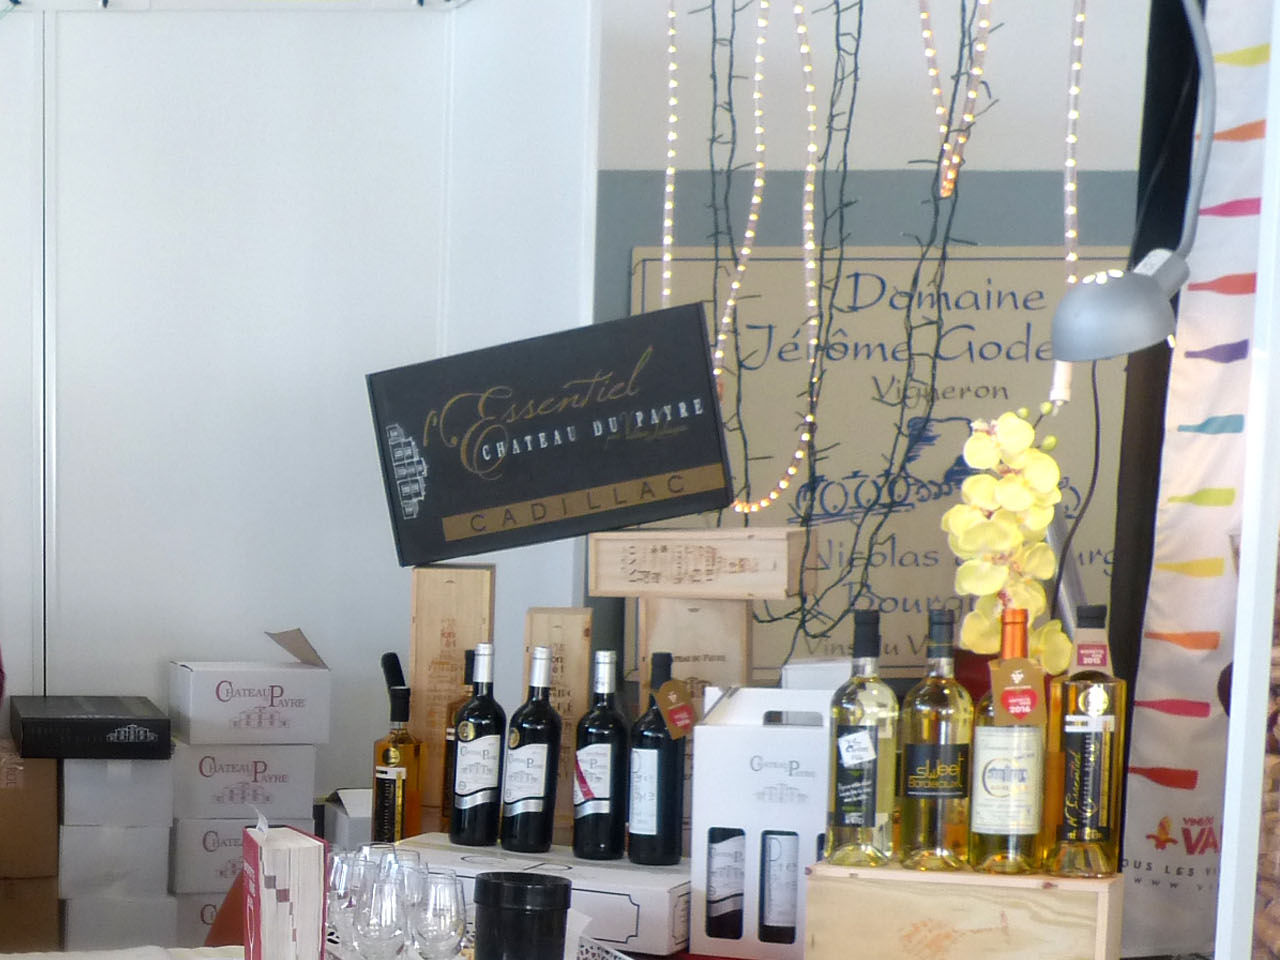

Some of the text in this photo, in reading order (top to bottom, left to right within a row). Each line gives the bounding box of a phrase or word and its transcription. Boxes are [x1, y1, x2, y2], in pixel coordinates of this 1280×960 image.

[846, 271, 1048, 312] Domaine
[741, 322, 1055, 371] Jérôme Gode
[871, 374, 1009, 409] Vigneron
[482, 398, 705, 461] CHATEAU DU PAYRE
[470, 474, 685, 533] CADILLAC
[216, 680, 305, 708] CHATEAU PAYRE
[198, 755, 289, 784] CHATEAU PAYRE
